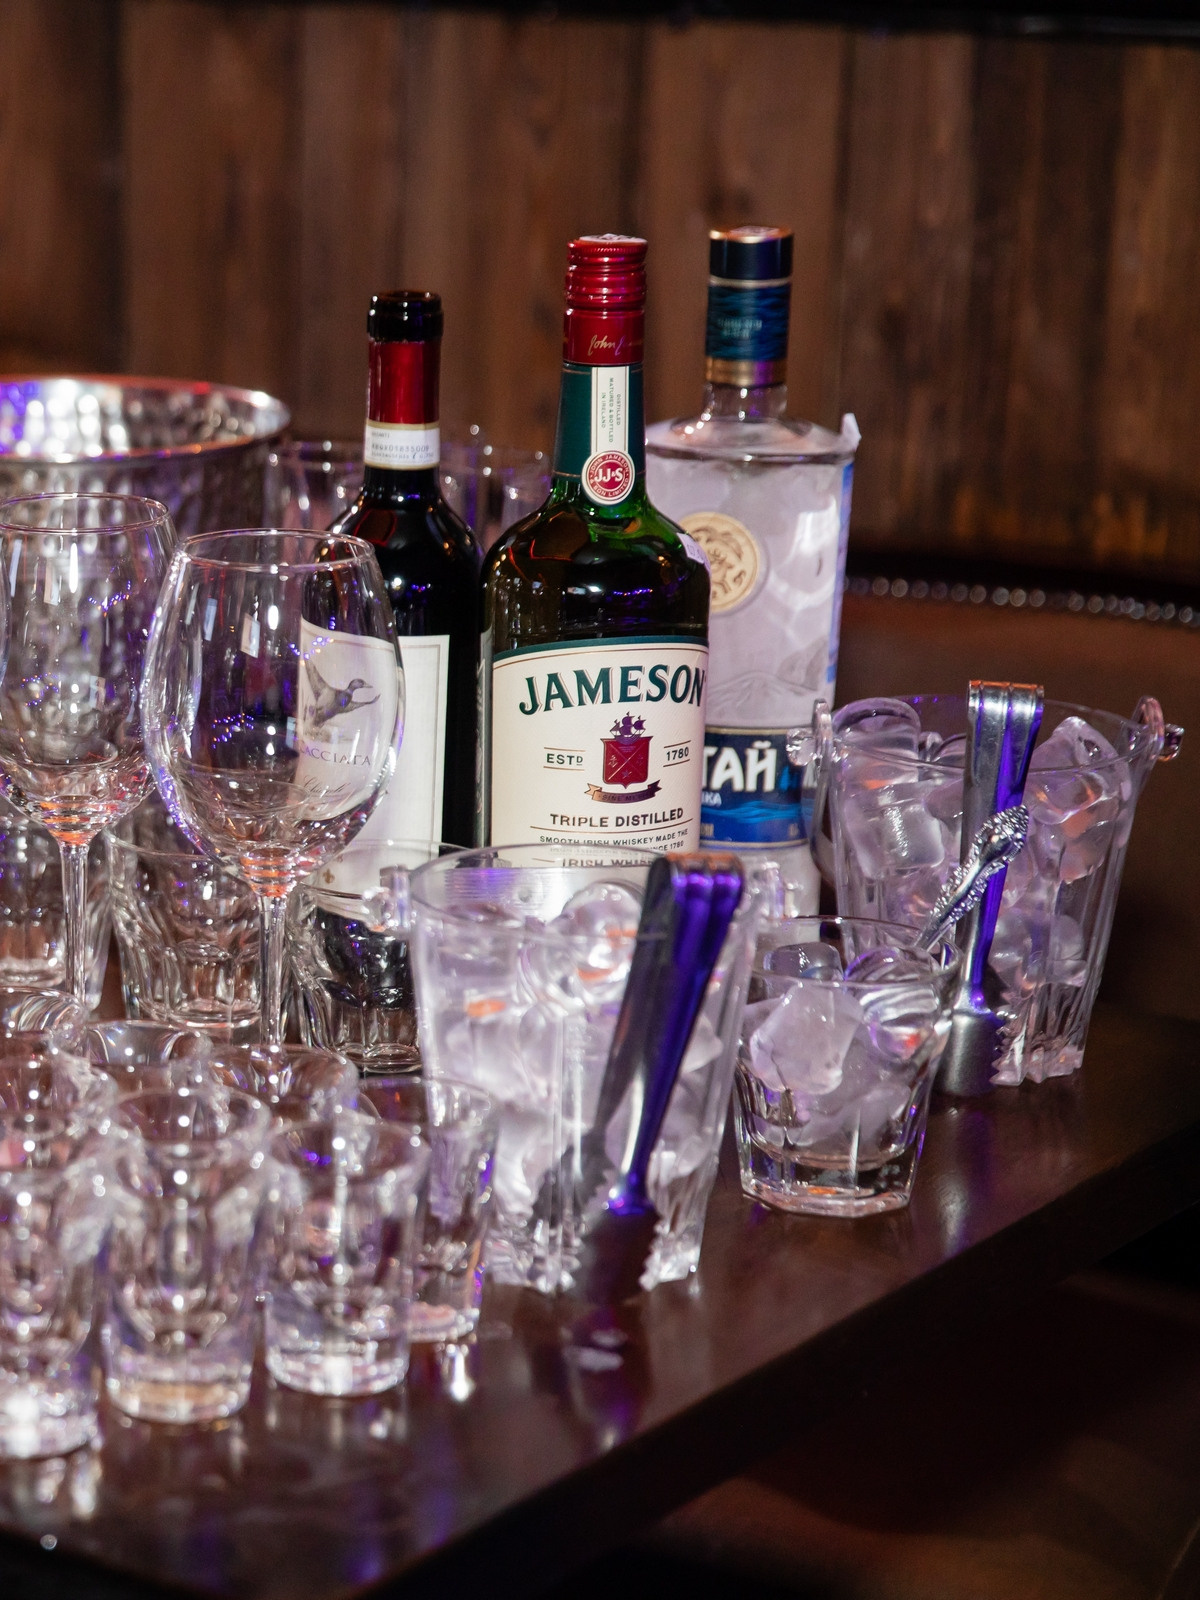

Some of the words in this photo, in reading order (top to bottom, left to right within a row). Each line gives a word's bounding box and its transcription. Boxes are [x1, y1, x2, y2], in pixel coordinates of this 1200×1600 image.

[519, 664, 705, 715] JAMESON
[666, 746, 689, 761] 1780
[702, 740, 777, 792] ТАЙ
[550, 813, 609, 828] TRIPLE
[615, 807, 684, 827] DISTILLED
[540, 835, 580, 845] SMOOTH
[613, 836, 654, 846] WHISKEY
[655, 832, 676, 842] MADE
[677, 828, 689, 837] THE
[670, 840, 684, 850] 1780
